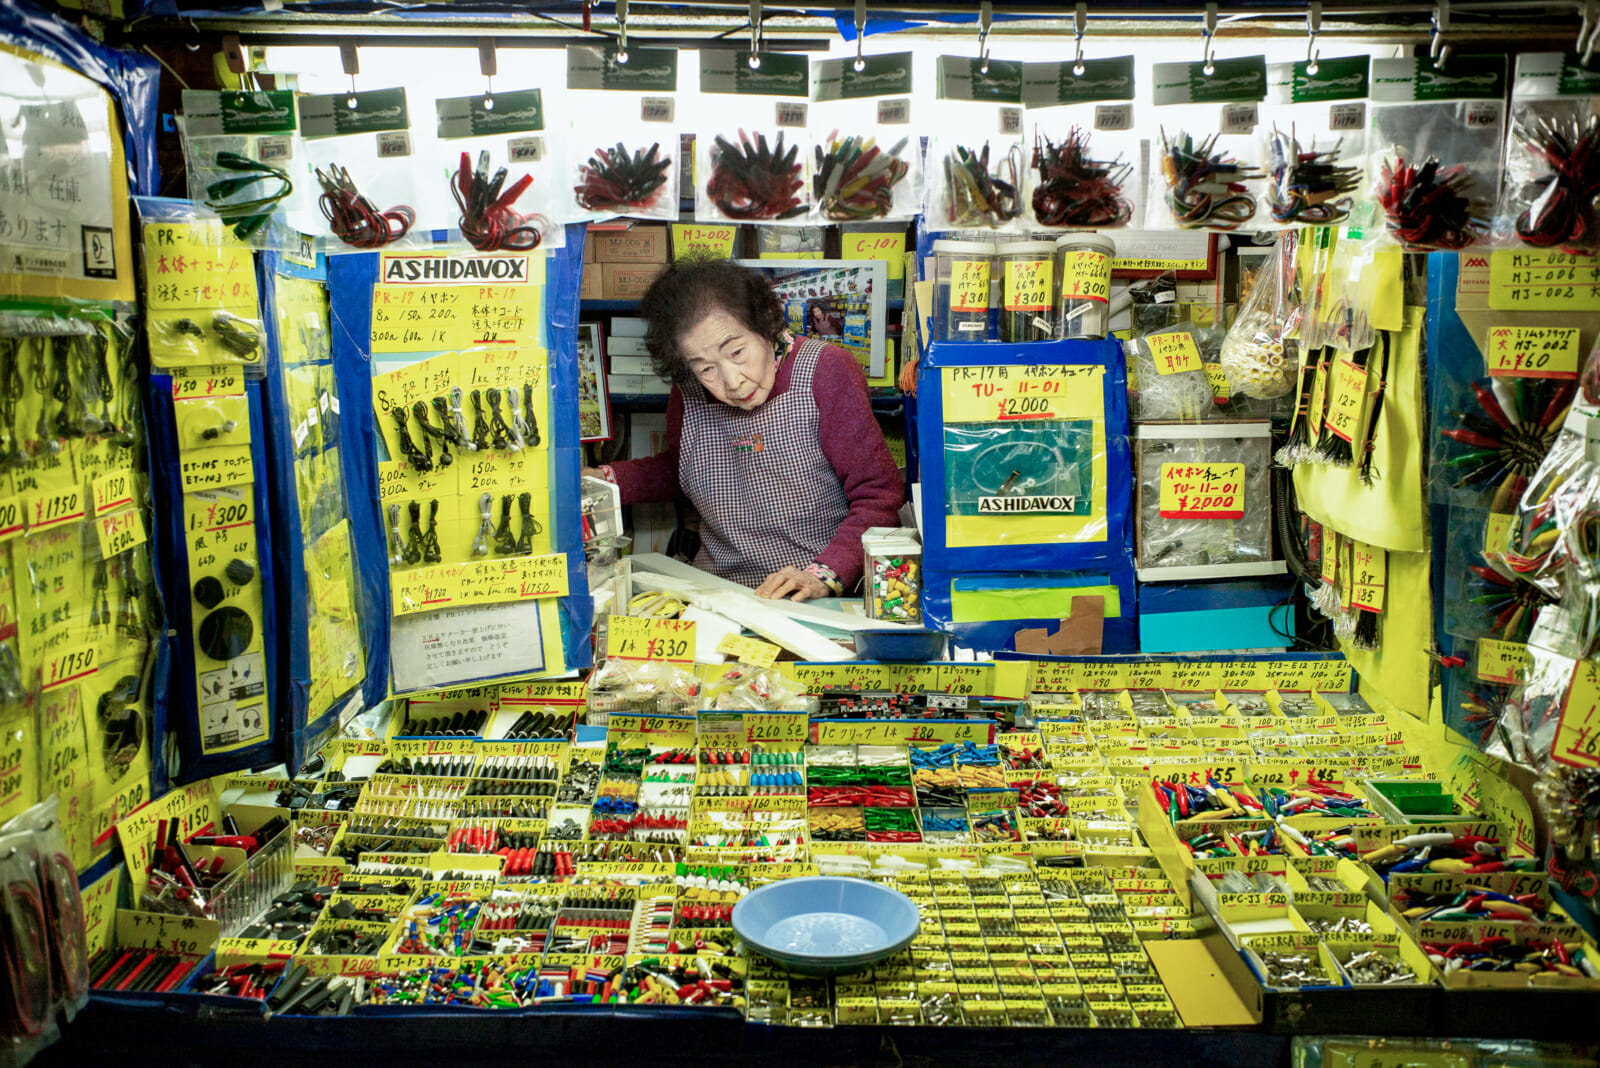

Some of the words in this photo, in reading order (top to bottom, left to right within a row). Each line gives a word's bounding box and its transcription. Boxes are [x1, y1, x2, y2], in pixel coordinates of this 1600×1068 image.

[683, 229, 731, 242] MJ-002
[856, 238, 898, 252] C-101
[387, 259, 525, 281] ASHIDAVOX
[1512, 267, 1576, 283] MJ-006
[480, 288, 516, 299] PR-17
[1073, 280, 1106, 295] ¥300
[1511, 287, 1575, 300] MJ-002
[374, 291, 415, 304] PR-17
[420, 292, 459, 304] イヤホン
[1014, 291, 1046, 305] ¥300
[1514, 340, 1569, 351] MJ-002
[1514, 352, 1550, 371] ¥60
[206, 375, 235, 393] ¥150
[471, 462, 497, 475] 150Ω
[471, 477, 498, 488] 200Ω
[980, 497, 1073, 511] ASHIDAVOX
[207, 503, 248, 526] ¥300
[103, 511, 134, 537] PR-17
[1357, 587, 1376, 603] ¥85
[647, 637, 688, 658] ¥330
[895, 682, 926, 694] ¥200
[945, 683, 973, 694] ¥180
[1093, 679, 1111, 688] ¥90
[1133, 678, 1154, 687] ¥90
[1181, 679, 1201, 688] ¥90
[1225, 679, 1249, 688] ¥120
[1273, 679, 1299, 689] ¥120
[1317, 679, 1345, 689] ¥130
[527, 685, 554, 698] ¥280
[611, 718, 637, 727] バナナ
[640, 717, 665, 731] ¥90
[746, 724, 781, 740] ¥260
[912, 726, 935, 739] ¥80
[1021, 734, 1038, 744] ¥60
[428, 741, 453, 754] ¥130
[516, 743, 540, 754] ¥110
[1189, 770, 1200, 783] 大
[1205, 766, 1236, 783] ¥55
[1289, 768, 1299, 784] 中
[747, 798, 769, 812] ¥160
[183, 804, 209, 837] ¥150
[381, 855, 408, 864] ¥200
[172, 937, 197, 952] ¥90
[428, 957, 456, 968] ¥65
[511, 955, 536, 967] ¥65
[594, 956, 622, 968] ¥70
